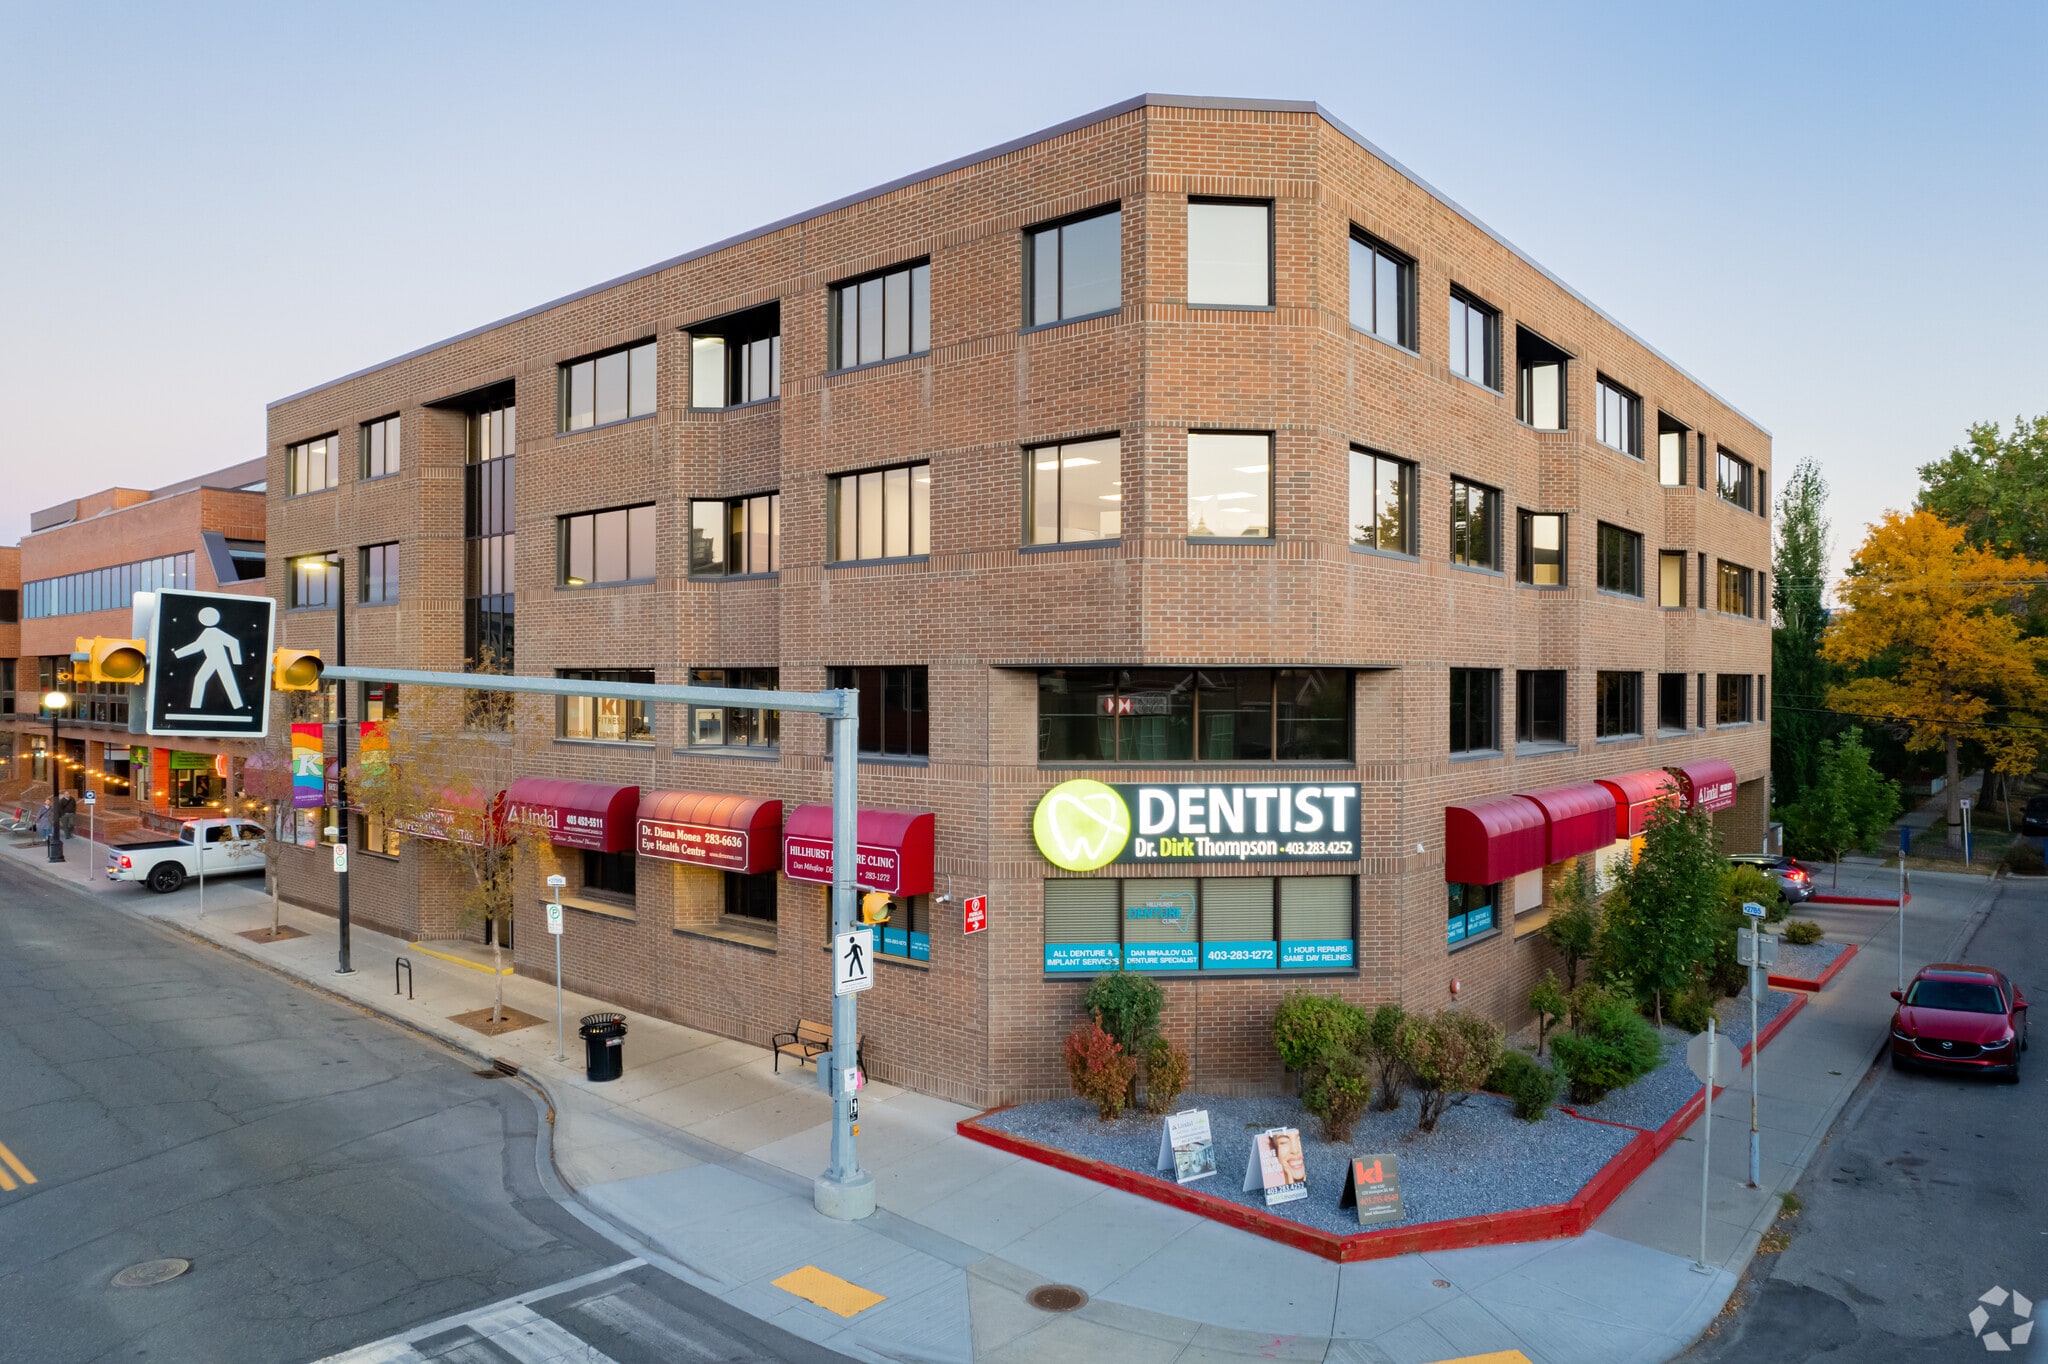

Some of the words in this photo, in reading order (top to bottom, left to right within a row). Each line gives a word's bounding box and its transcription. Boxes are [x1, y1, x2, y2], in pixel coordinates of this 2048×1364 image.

[597, 716, 625, 725] FITNESS
[296, 753, 322, 777] K
[1138, 786, 1356, 834] DENTIST
[520, 806, 559, 829] Lindal
[566, 814, 577, 825] 403
[642, 825, 653, 836] Dr.
[654, 827, 676, 839] Diana
[677, 829, 701, 842] Monea
[704, 833, 742, 848] 283-6636
[641, 839, 655, 851] Eye
[655, 840, 680, 853] Health
[681, 844, 706, 857] Centre
[1135, 839, 1158, 857] Dr.
[1159, 837, 1194, 857] Dirk
[1195, 837, 1278, 860] Thompson
[1285, 841, 1353, 856] 403.283.4252
[789, 845, 829, 860] HILLHURST
[867, 856, 895, 869] CLINIC
[793, 861, 804, 870] Dan
[864, 872, 890, 882] 283-1272
[1127, 907, 1182, 920] DENTURE
[1069, 949, 1105, 957] DENTURE
[1130, 949, 1145, 957] DAN
[1146, 949, 1180, 957] MIHAJLOV
[1207, 949, 1272, 960] 403-283-1272
[1317, 945, 1348, 953] REPAIRS
[1047, 958, 1080, 966] IMPLANT
[1159, 956, 1198, 964] SPECIALIST
[1321, 953, 1352, 961] RELINES
